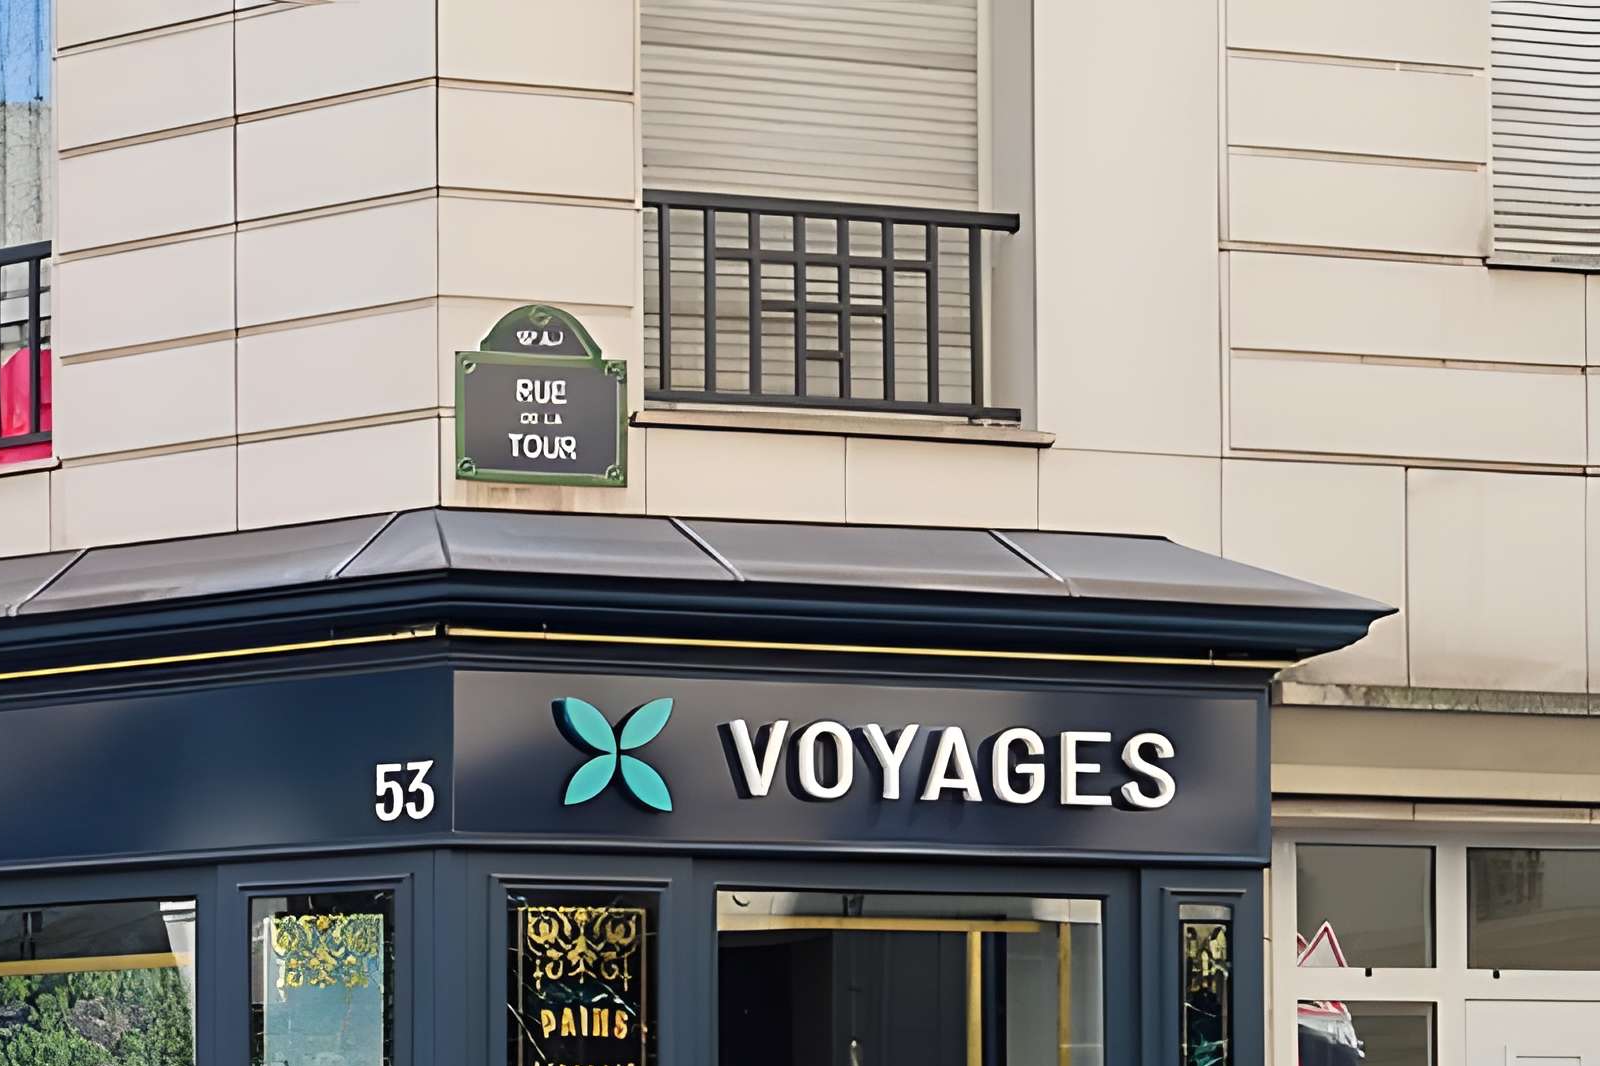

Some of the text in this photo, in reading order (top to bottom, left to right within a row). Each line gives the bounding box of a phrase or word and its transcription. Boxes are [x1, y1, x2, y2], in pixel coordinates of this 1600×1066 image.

[516, 379, 567, 405] RUE
[508, 433, 577, 460] TOUR
[729, 719, 1175, 809] VOYAGES
[376, 760, 434, 822] 53
